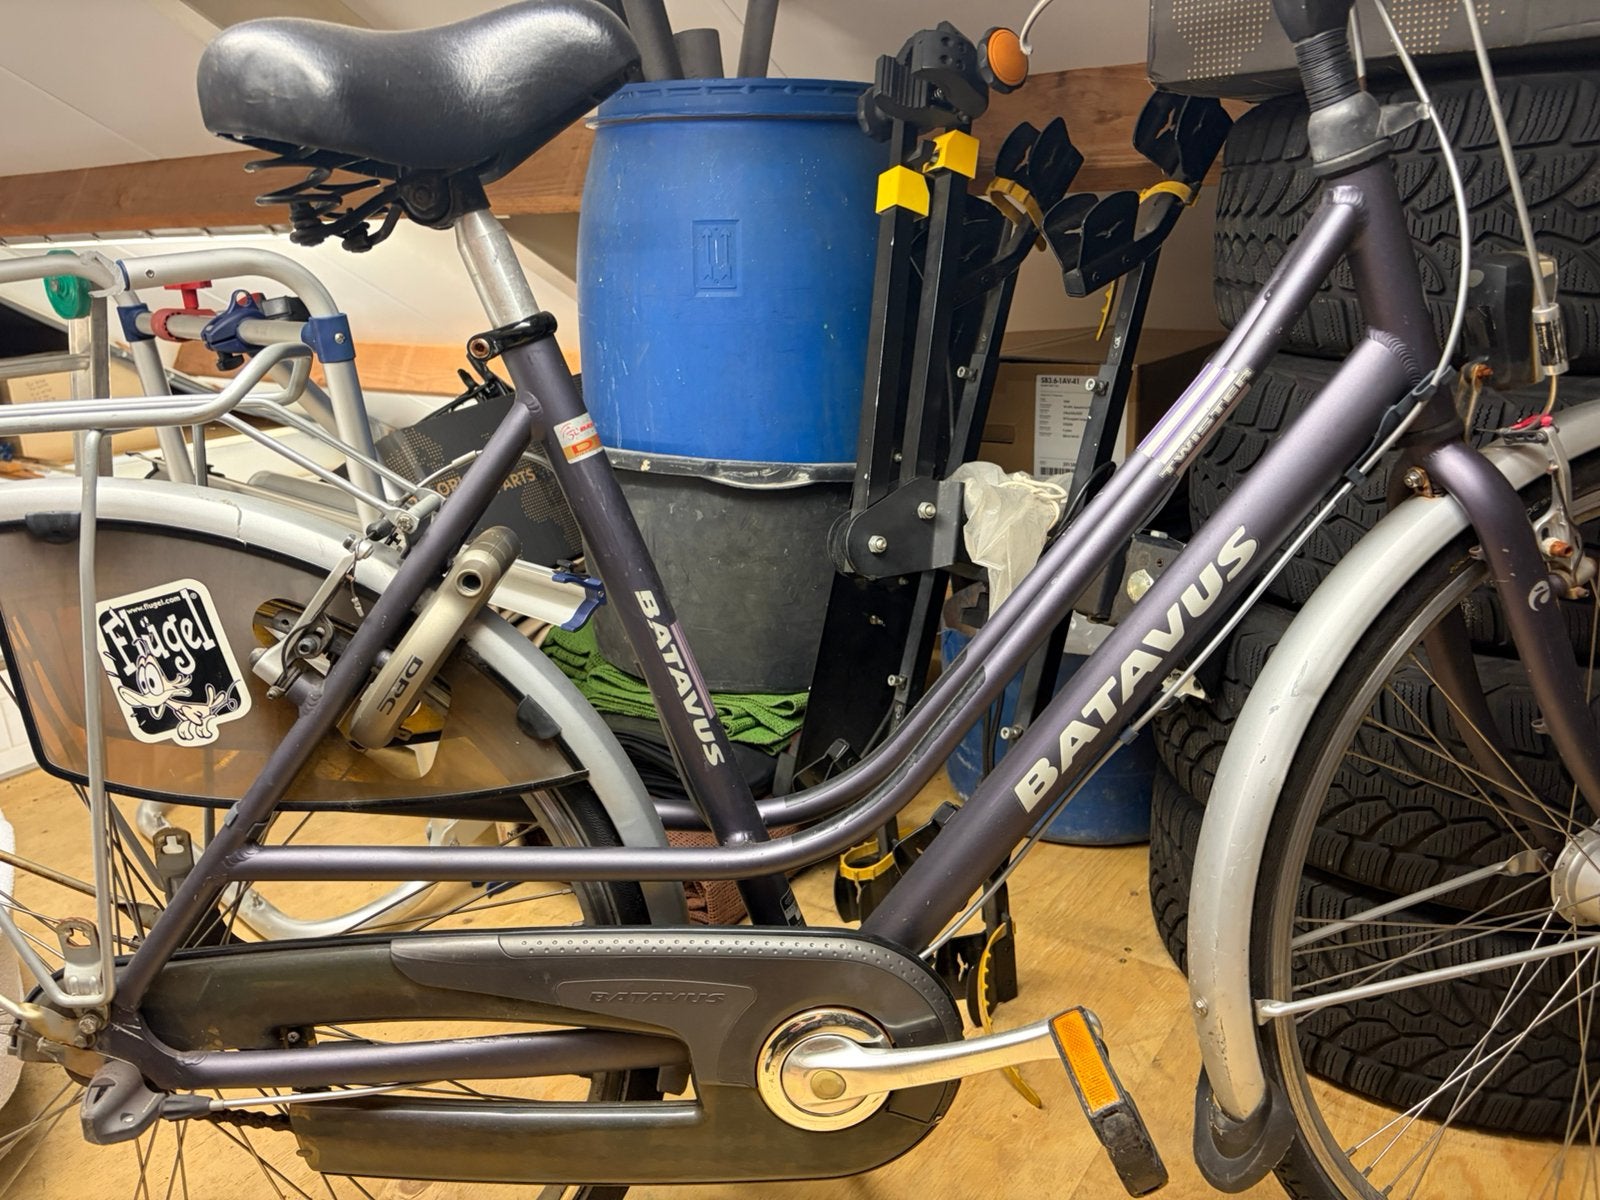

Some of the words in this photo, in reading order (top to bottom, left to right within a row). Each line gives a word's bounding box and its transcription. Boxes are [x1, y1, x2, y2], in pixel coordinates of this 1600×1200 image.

[1159, 367, 1253, 479] TWISTER
[502, 468, 536, 492] ARTS
[103, 588, 216, 677] Flügel
[634, 590, 726, 767] BATAVUS
[1014, 525, 1258, 814] BATAVUS
[589, 991, 727, 1004] BATAVUS
